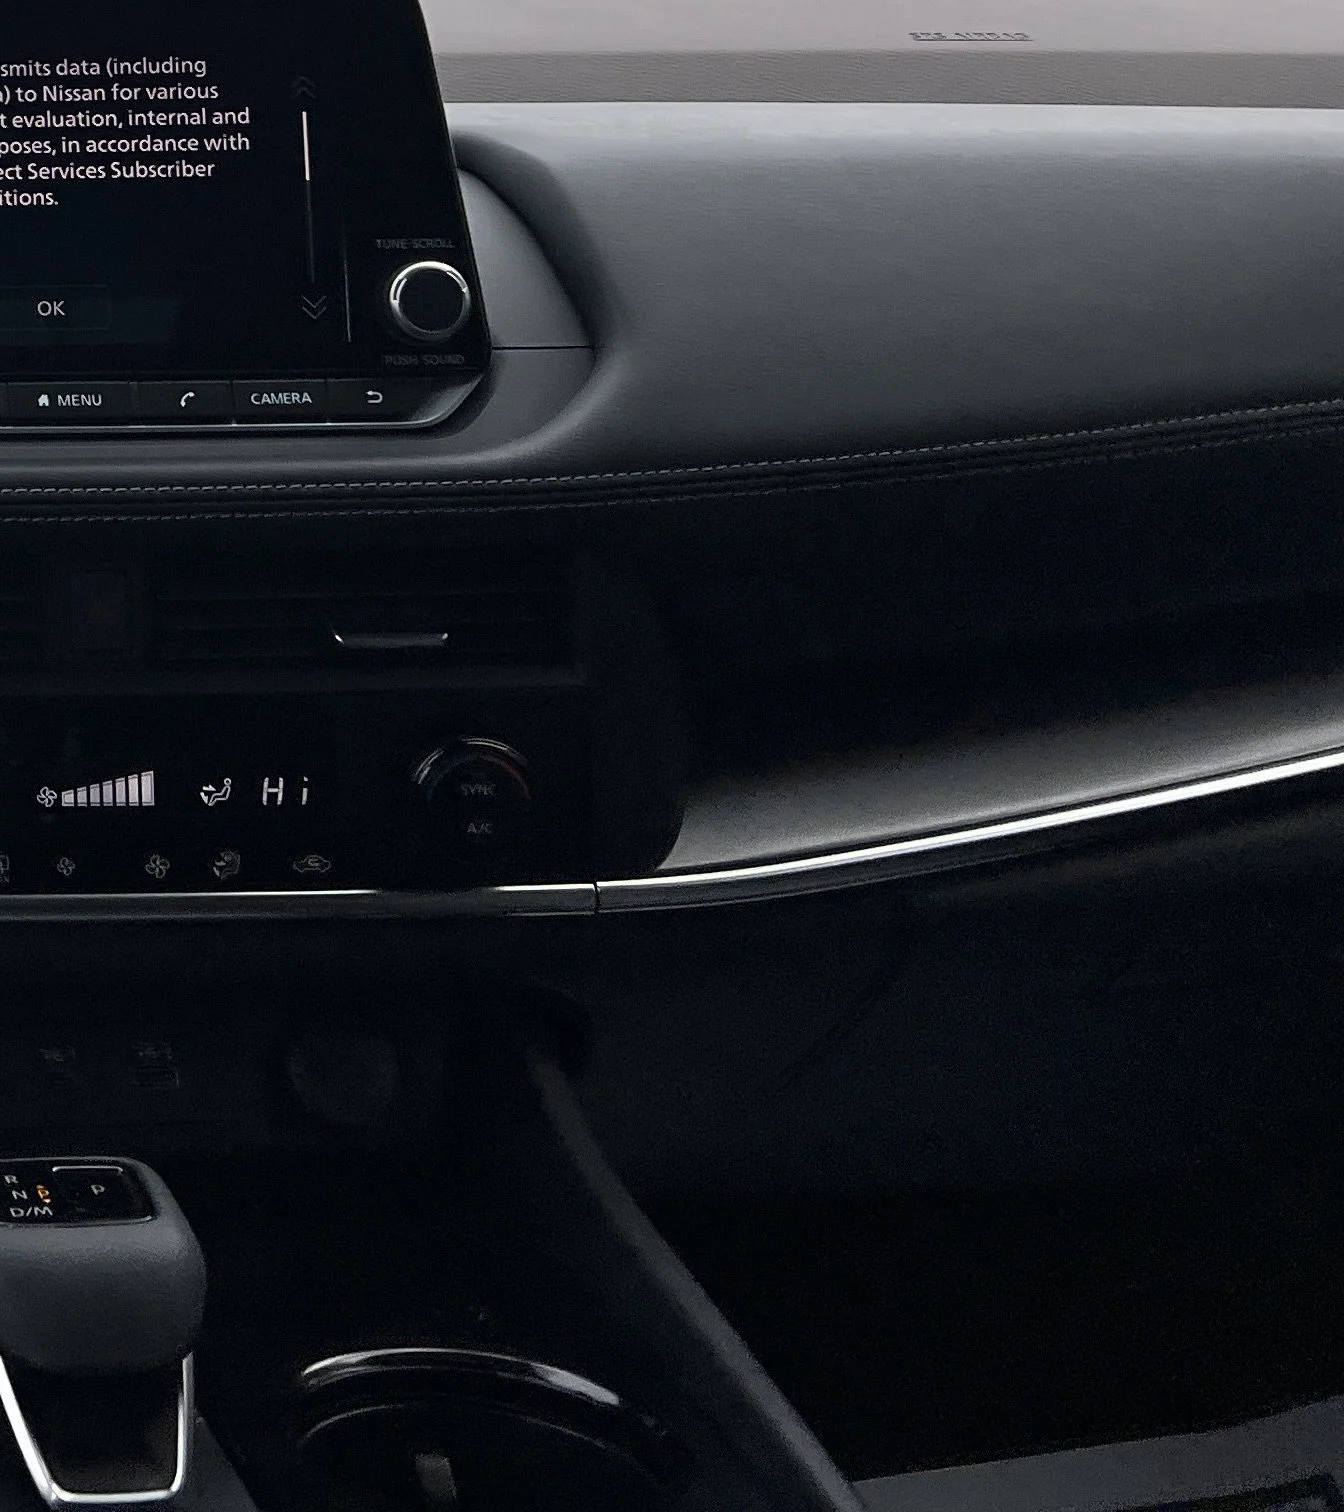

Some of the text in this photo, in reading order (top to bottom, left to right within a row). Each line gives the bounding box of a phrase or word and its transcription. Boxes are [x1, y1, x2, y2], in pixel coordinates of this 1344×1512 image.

[55, 58, 101, 76] data
[106, 55, 207, 78] (including
[14, 87, 37, 103] to
[42, 84, 106, 102] Nissan
[110, 82, 142, 101] for
[145, 82, 219, 100] various
[11, 109, 123, 129] evaluation,
[128, 107, 207, 126] internal
[211, 106, 250, 125] and
[61, 136, 81, 153] in
[85, 134, 199, 153] accordance
[203, 132, 250, 151] with
[27, 162, 107, 180] Services
[110, 159, 216, 179] Subscriber
[36, 299, 66, 318] OK
[56, 393, 103, 408] MENU
[249, 390, 314, 406] CAMERA
[3, 1174, 19, 1185] R
[11, 1189, 29, 1200] N
[90, 1183, 106, 1196] P
[8, 1205, 54, 1218] D/M
